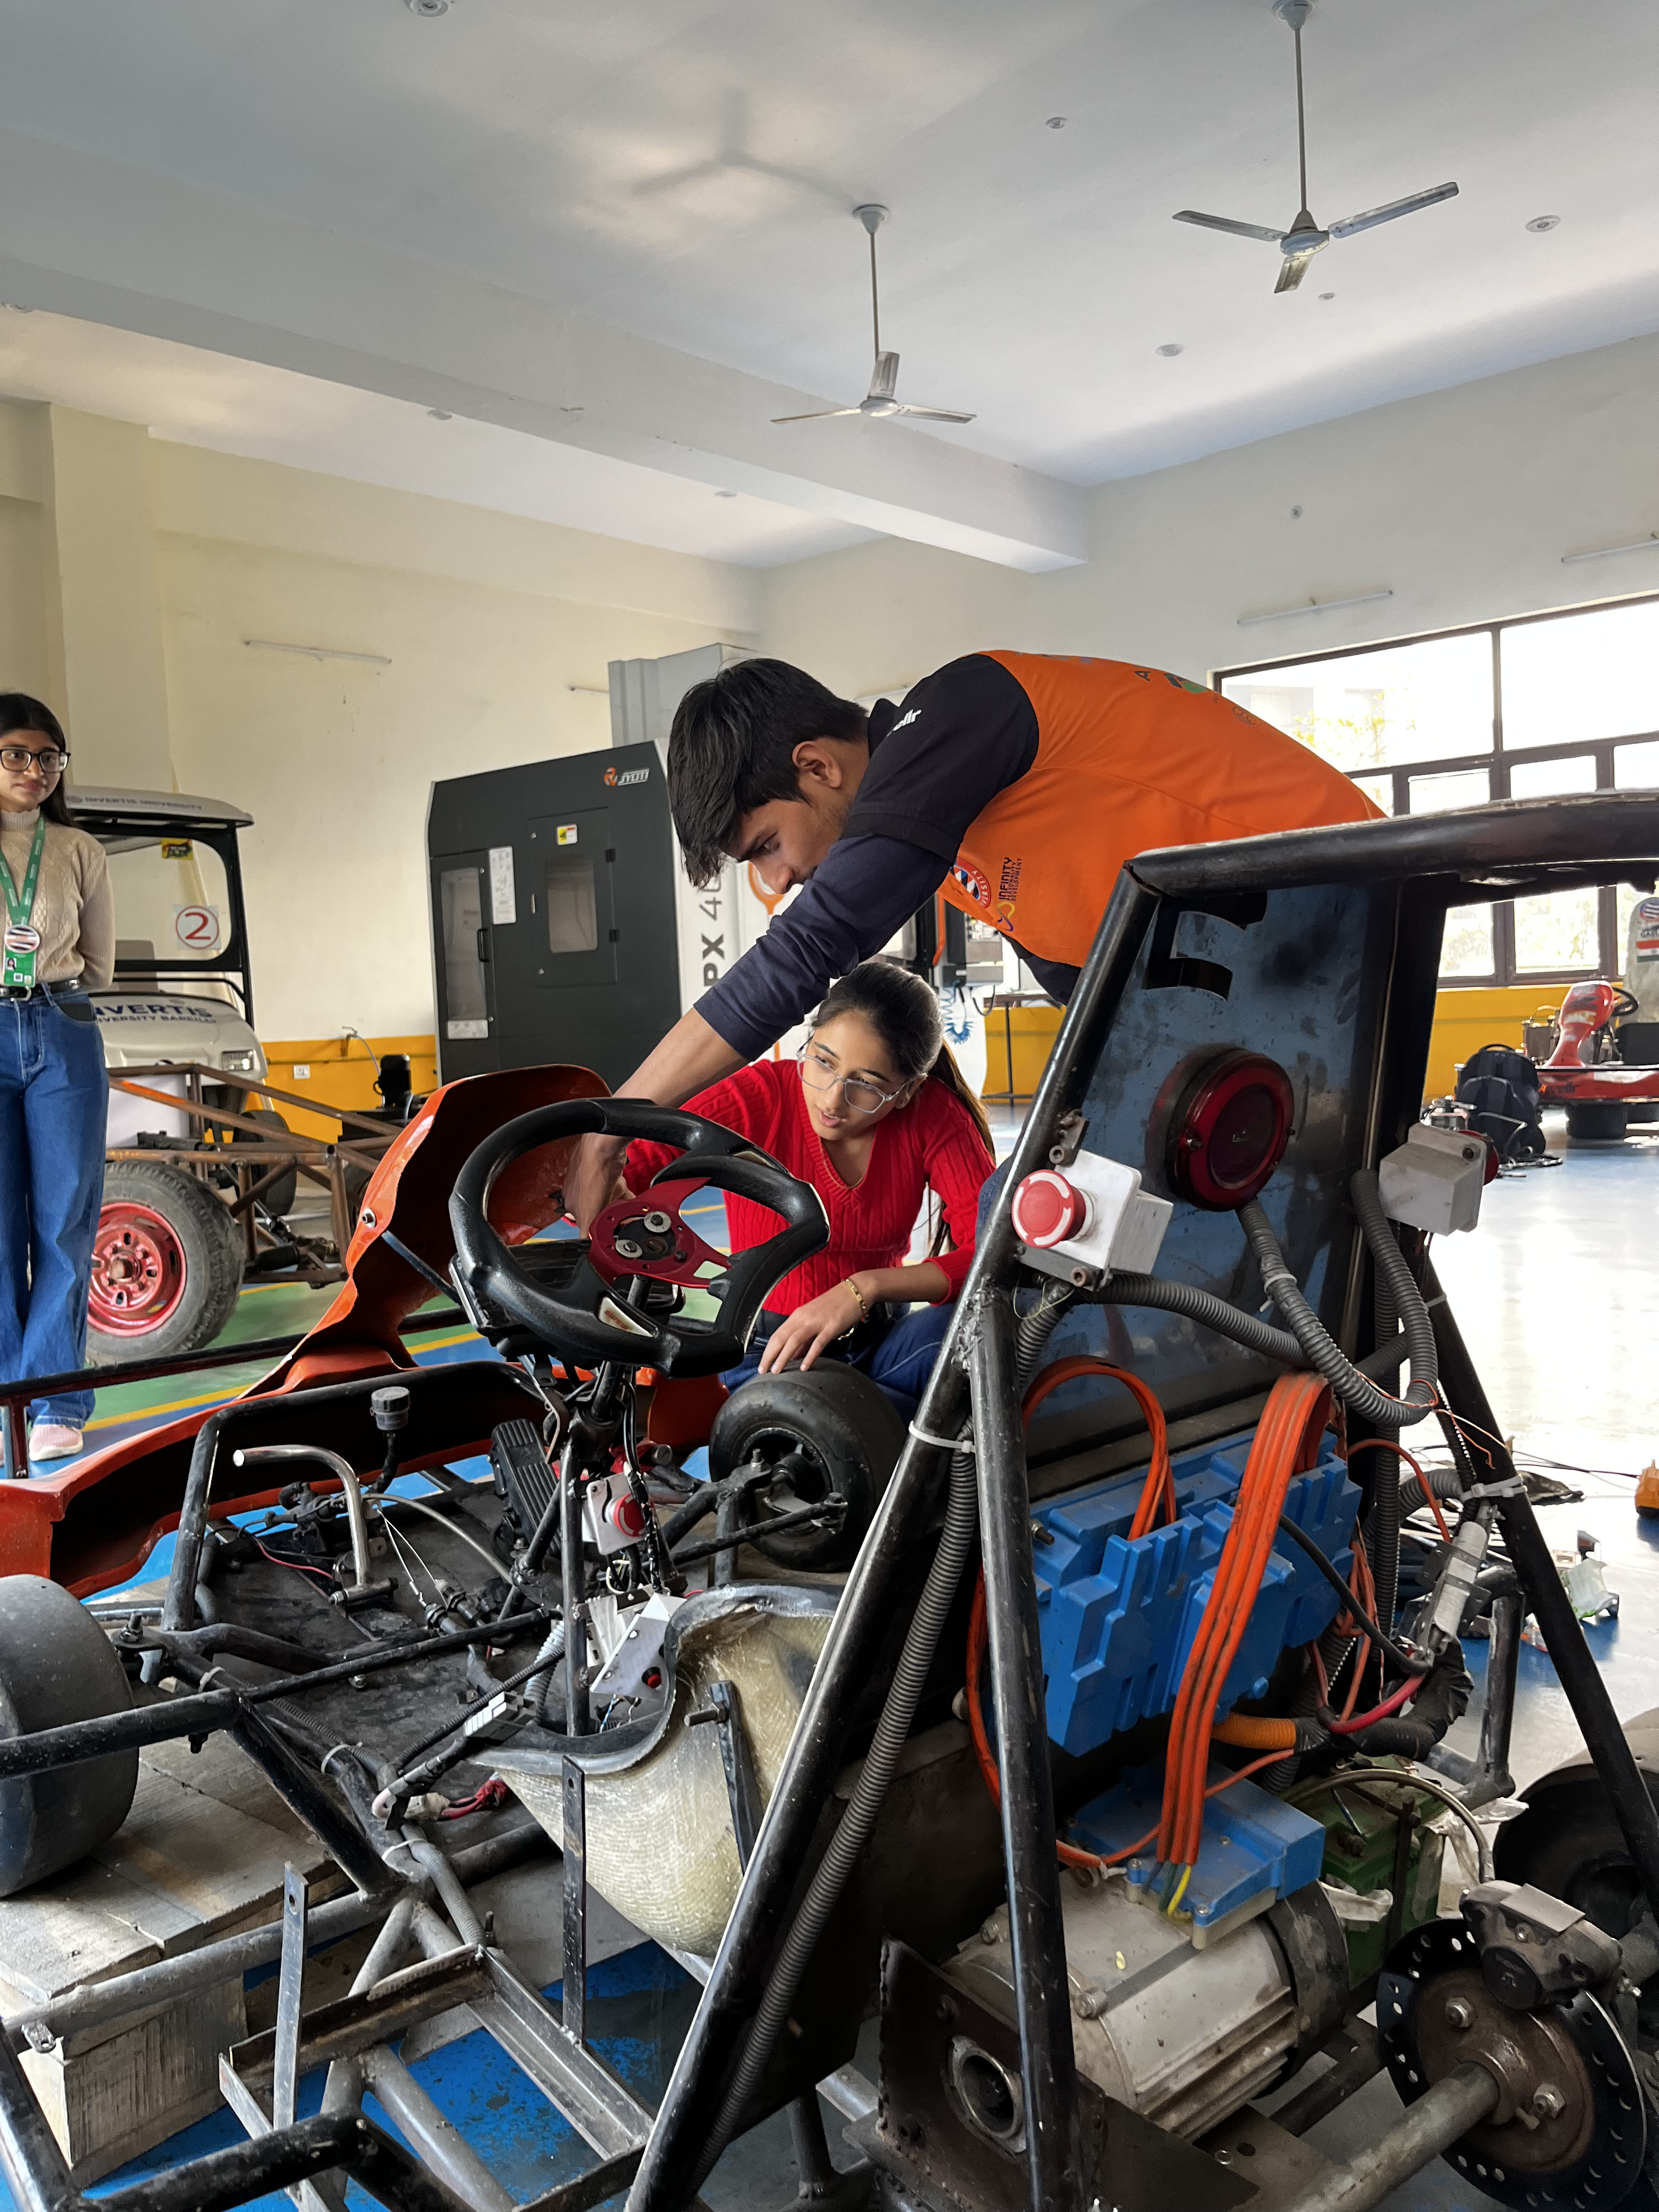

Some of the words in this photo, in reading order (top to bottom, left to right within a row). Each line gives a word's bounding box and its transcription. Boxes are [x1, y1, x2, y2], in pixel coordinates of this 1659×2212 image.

[971, 870, 989, 907] IVERSITY
[998, 857, 1012, 900] INFINITY
[1011, 858, 1022, 901] DEVELOPMENT
[185, 911, 211, 940] 2
